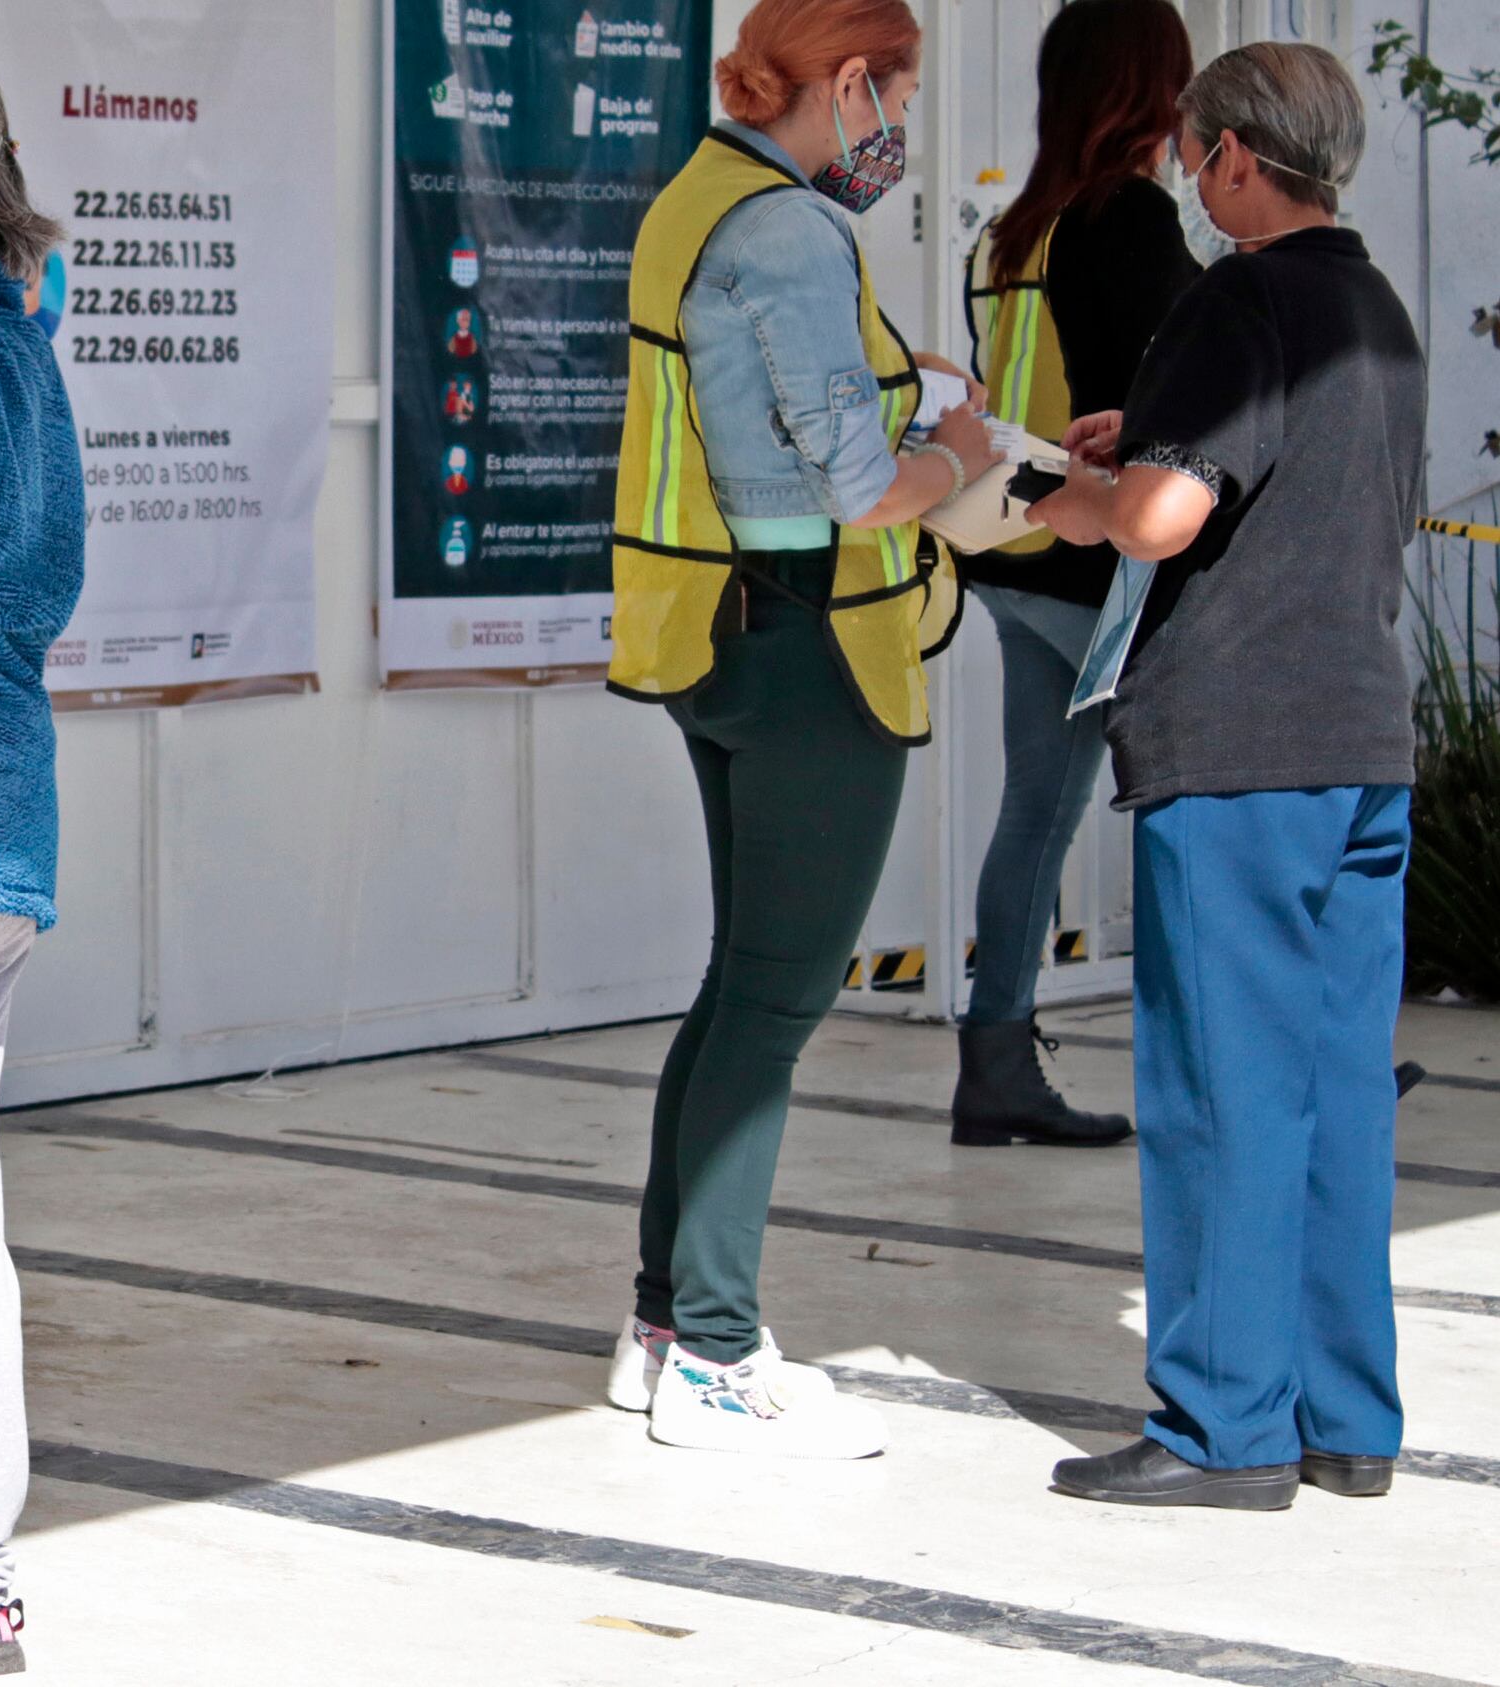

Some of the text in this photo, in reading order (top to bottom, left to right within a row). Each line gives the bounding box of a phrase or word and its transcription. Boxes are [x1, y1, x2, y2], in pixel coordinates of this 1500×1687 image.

[466, 8, 513, 28] Alta de
[466, 29, 513, 46] auxiliar
[601, 20, 649, 37] Cambio
[600, 40, 642, 56] medio
[62, 84, 198, 123] Llámanos
[496, 90, 514, 108] de
[600, 96, 653, 116] Baja del
[409, 174, 455, 192] SIGUE
[528, 180, 542, 198] DE
[73, 190, 232, 221] 22.26.63.64.51
[72, 239, 237, 269] 22.22.26.11.53
[556, 246, 566, 262] el
[589, 251, 597, 266] y
[71, 288, 237, 316] 22.26.69.22.23
[555, 317, 608, 336] personal
[72, 336, 240, 363] 22.29.60.62.86
[527, 377, 554, 390] caso
[533, 396, 554, 407] con
[557, 396, 571, 407] un
[85, 424, 231, 448] Lunes a viernes
[86, 459, 251, 486] de 9:00 a 15:00 hrs.
[486, 454, 502, 470] Es
[504, 454, 563, 473] obligatorio
[564, 454, 576, 469] el
[85, 505, 96, 528] y
[101, 501, 124, 523] de
[129, 498, 174, 522] 16:00
[178, 505, 189, 520] a
[194, 497, 236, 520] 18:00
[483, 523, 496, 538] Al
[498, 526, 536, 539] entrar
[538, 524, 549, 538] te
[472, 630, 524, 647] MÉXICO
[46, 651, 86, 667] ÉXICO
